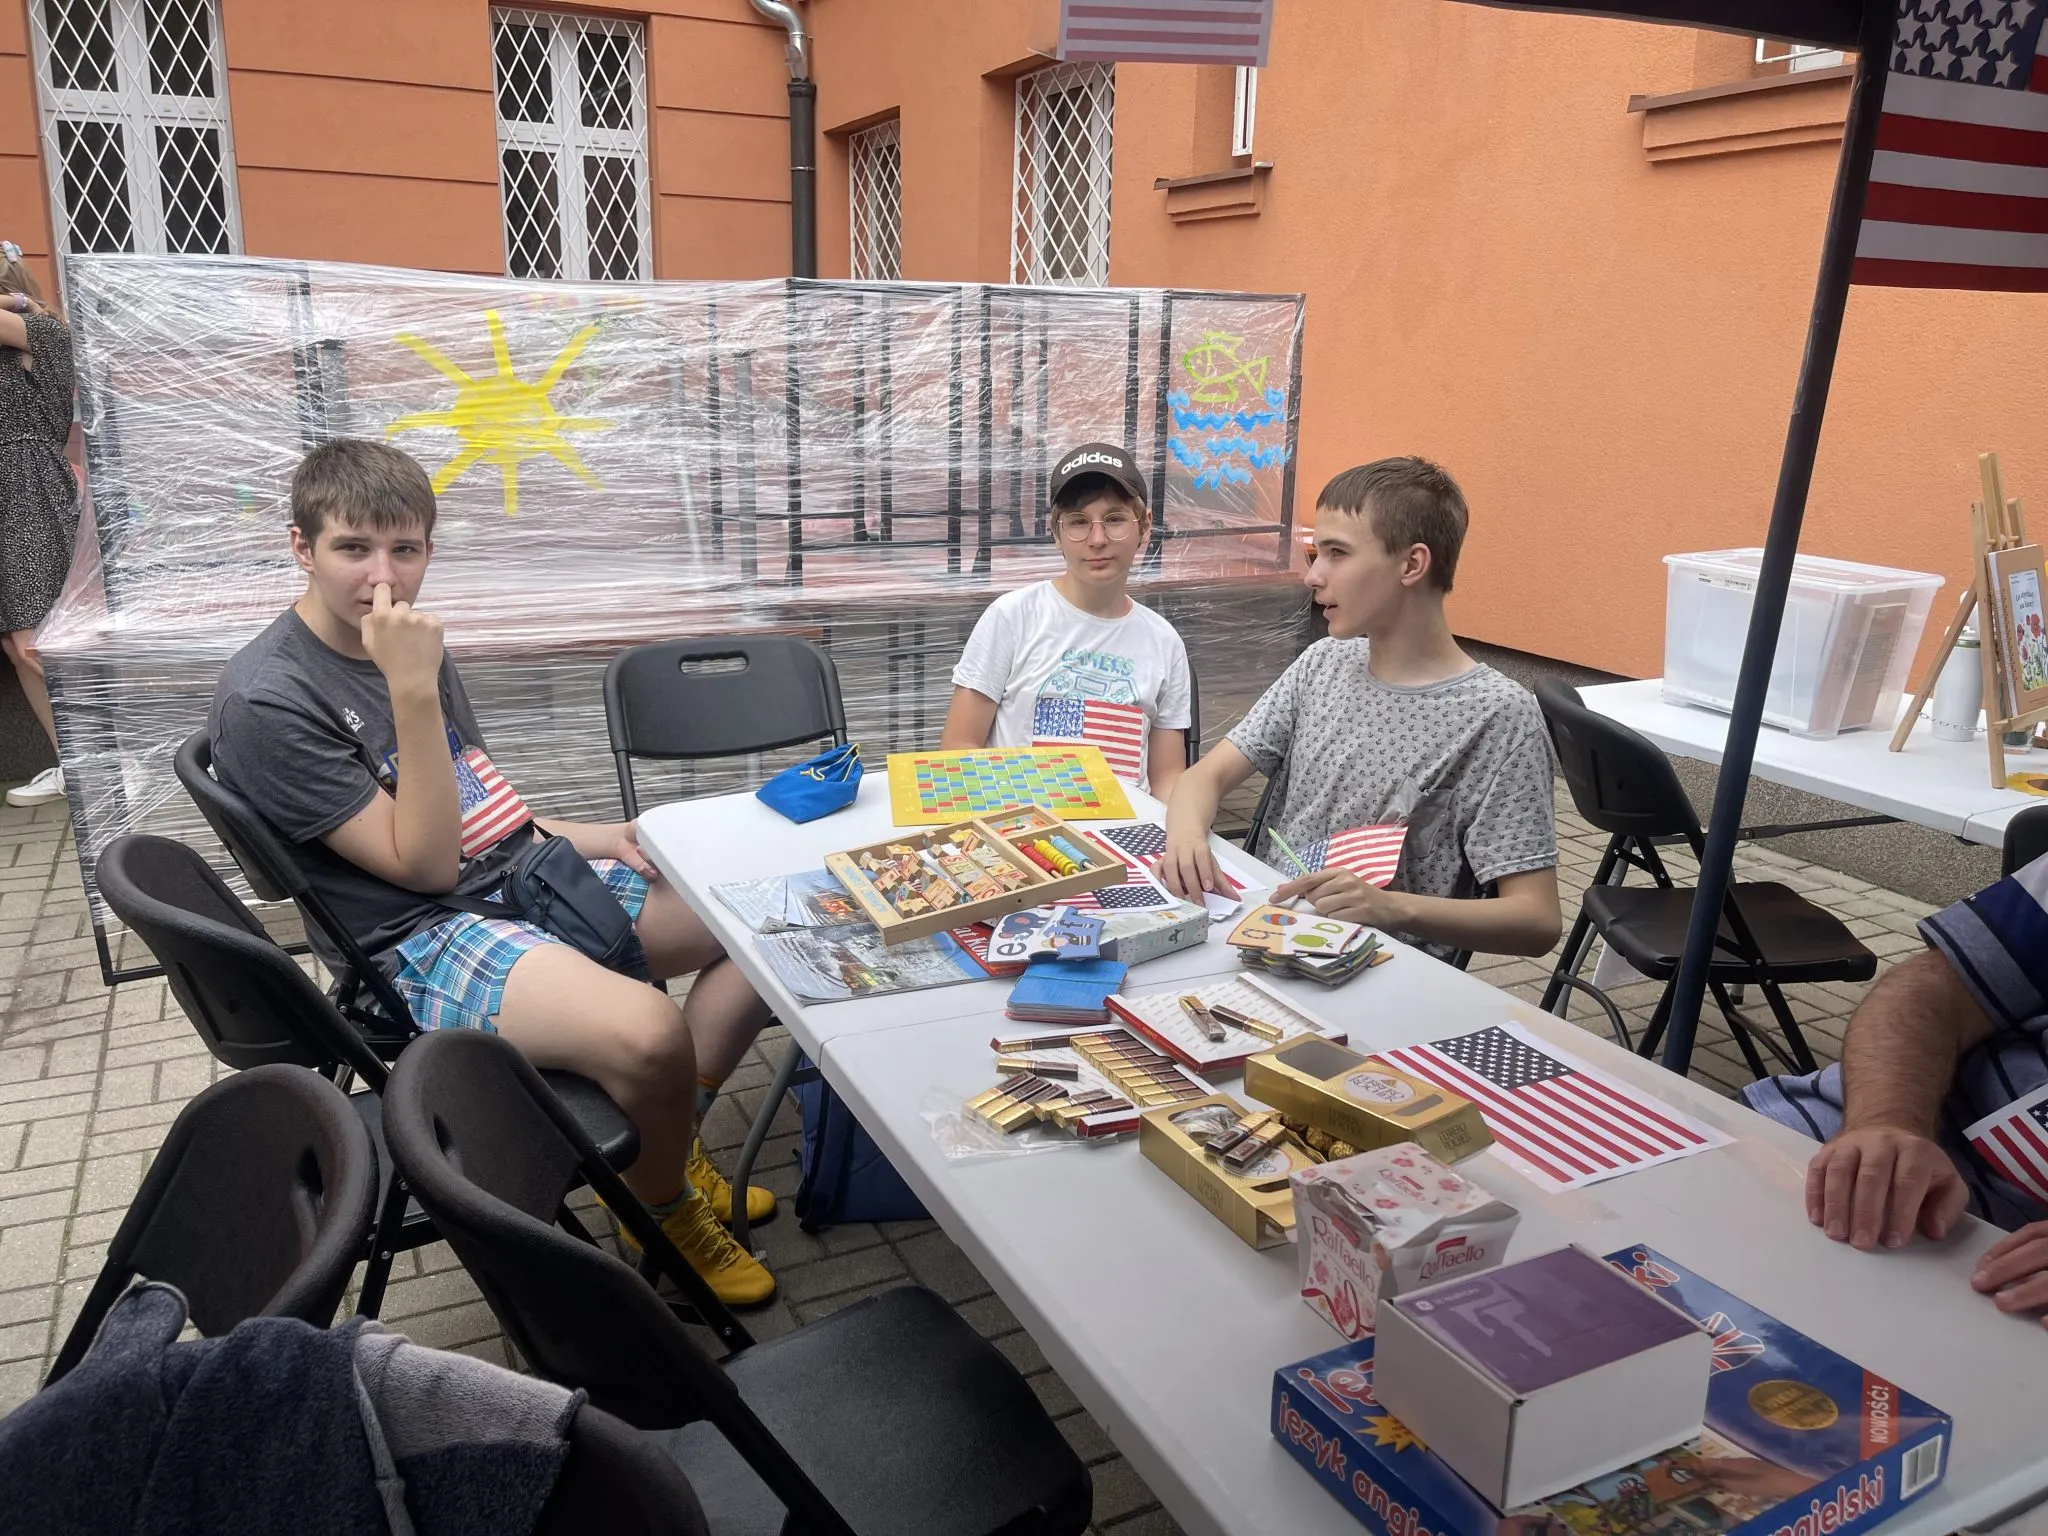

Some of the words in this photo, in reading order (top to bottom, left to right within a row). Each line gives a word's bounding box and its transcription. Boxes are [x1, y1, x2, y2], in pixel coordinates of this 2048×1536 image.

[1061, 452, 1123, 475] adidas
[1348, 1078, 1394, 1103] ROCHER
[1354, 1073, 1405, 1100] FERRERO
[1438, 1122, 1467, 1142] FERRERO
[1442, 1132, 1472, 1151] ROCHER
[1378, 1168, 1426, 1201] Raffaello
[1312, 1215, 1375, 1292] Raffaello
[1419, 1245, 1485, 1282] Raffaello
[1867, 1384, 1890, 1444] NOWOŚĆ!
[1279, 1391, 1347, 1482] język
[1352, 1469, 1446, 1536] angi
